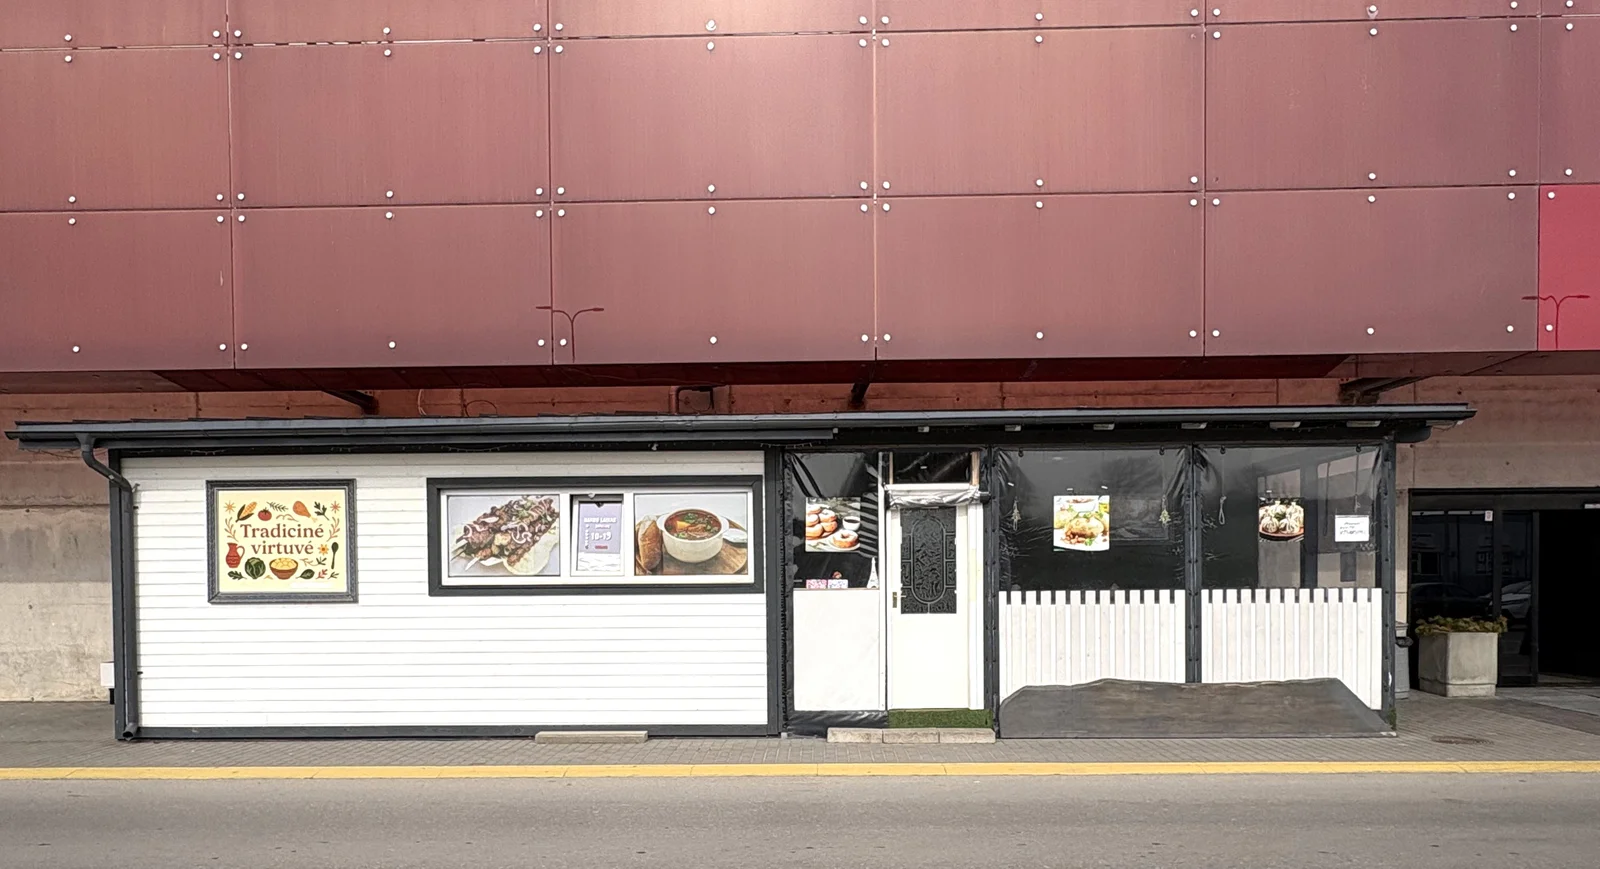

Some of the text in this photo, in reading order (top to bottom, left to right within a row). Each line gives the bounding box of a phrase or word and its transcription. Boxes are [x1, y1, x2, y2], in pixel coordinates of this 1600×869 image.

[240, 523, 324, 538] Tradiciné
[591, 531, 612, 541] 10-19
[251, 540, 314, 555] virtuvé
